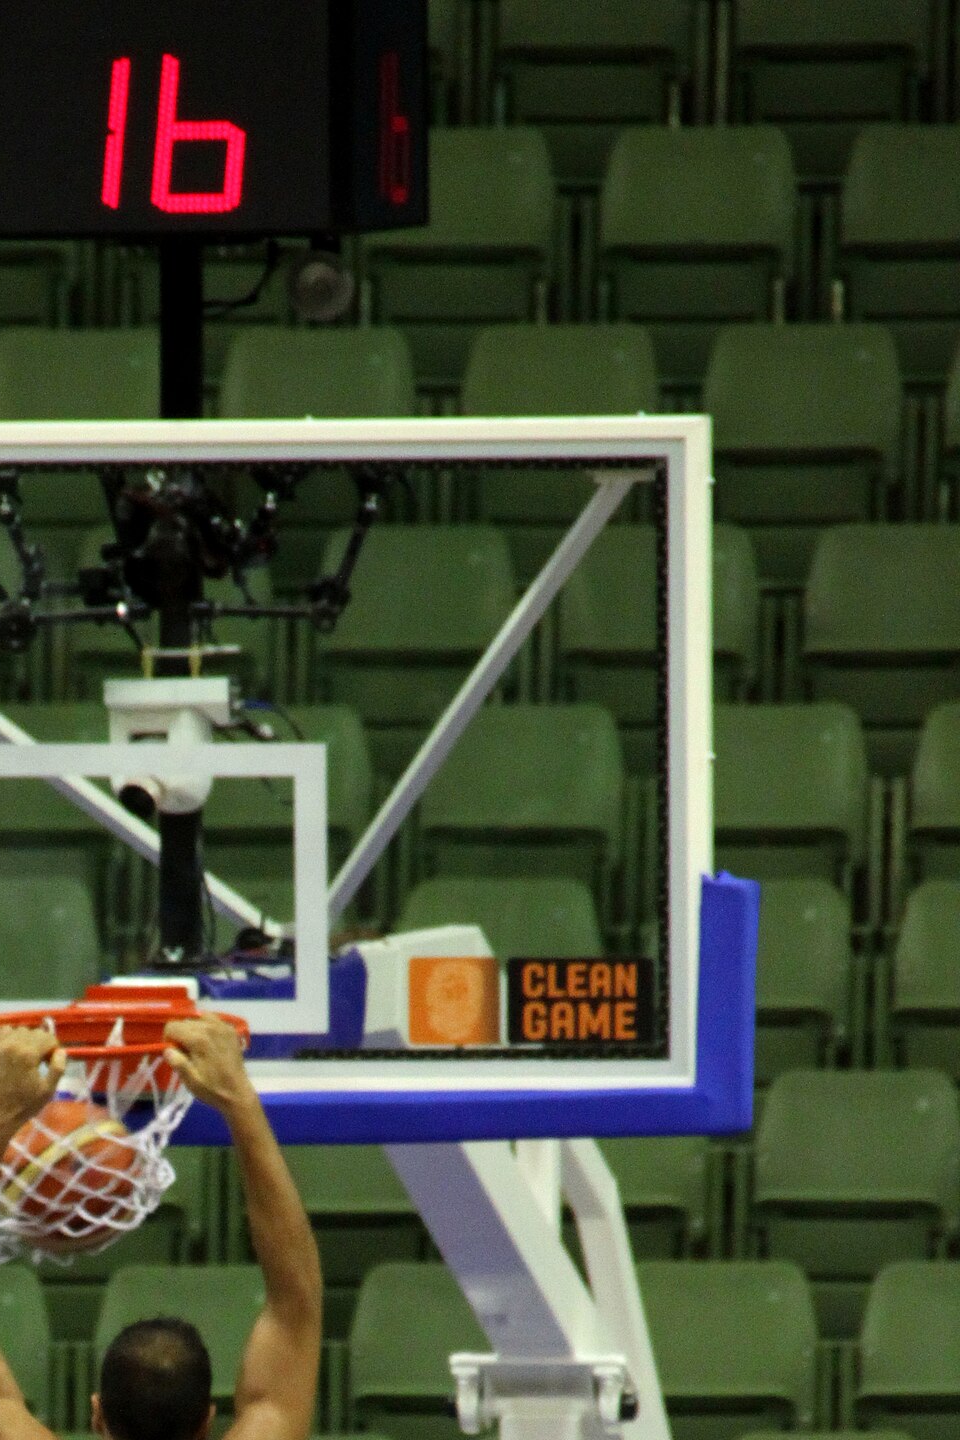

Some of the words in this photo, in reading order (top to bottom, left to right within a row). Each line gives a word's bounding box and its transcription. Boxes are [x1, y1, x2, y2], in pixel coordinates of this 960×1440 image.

[101, 53, 246, 214] 16
[521, 962, 638, 999] CLEAN
[521, 1002, 638, 1041] GAME
